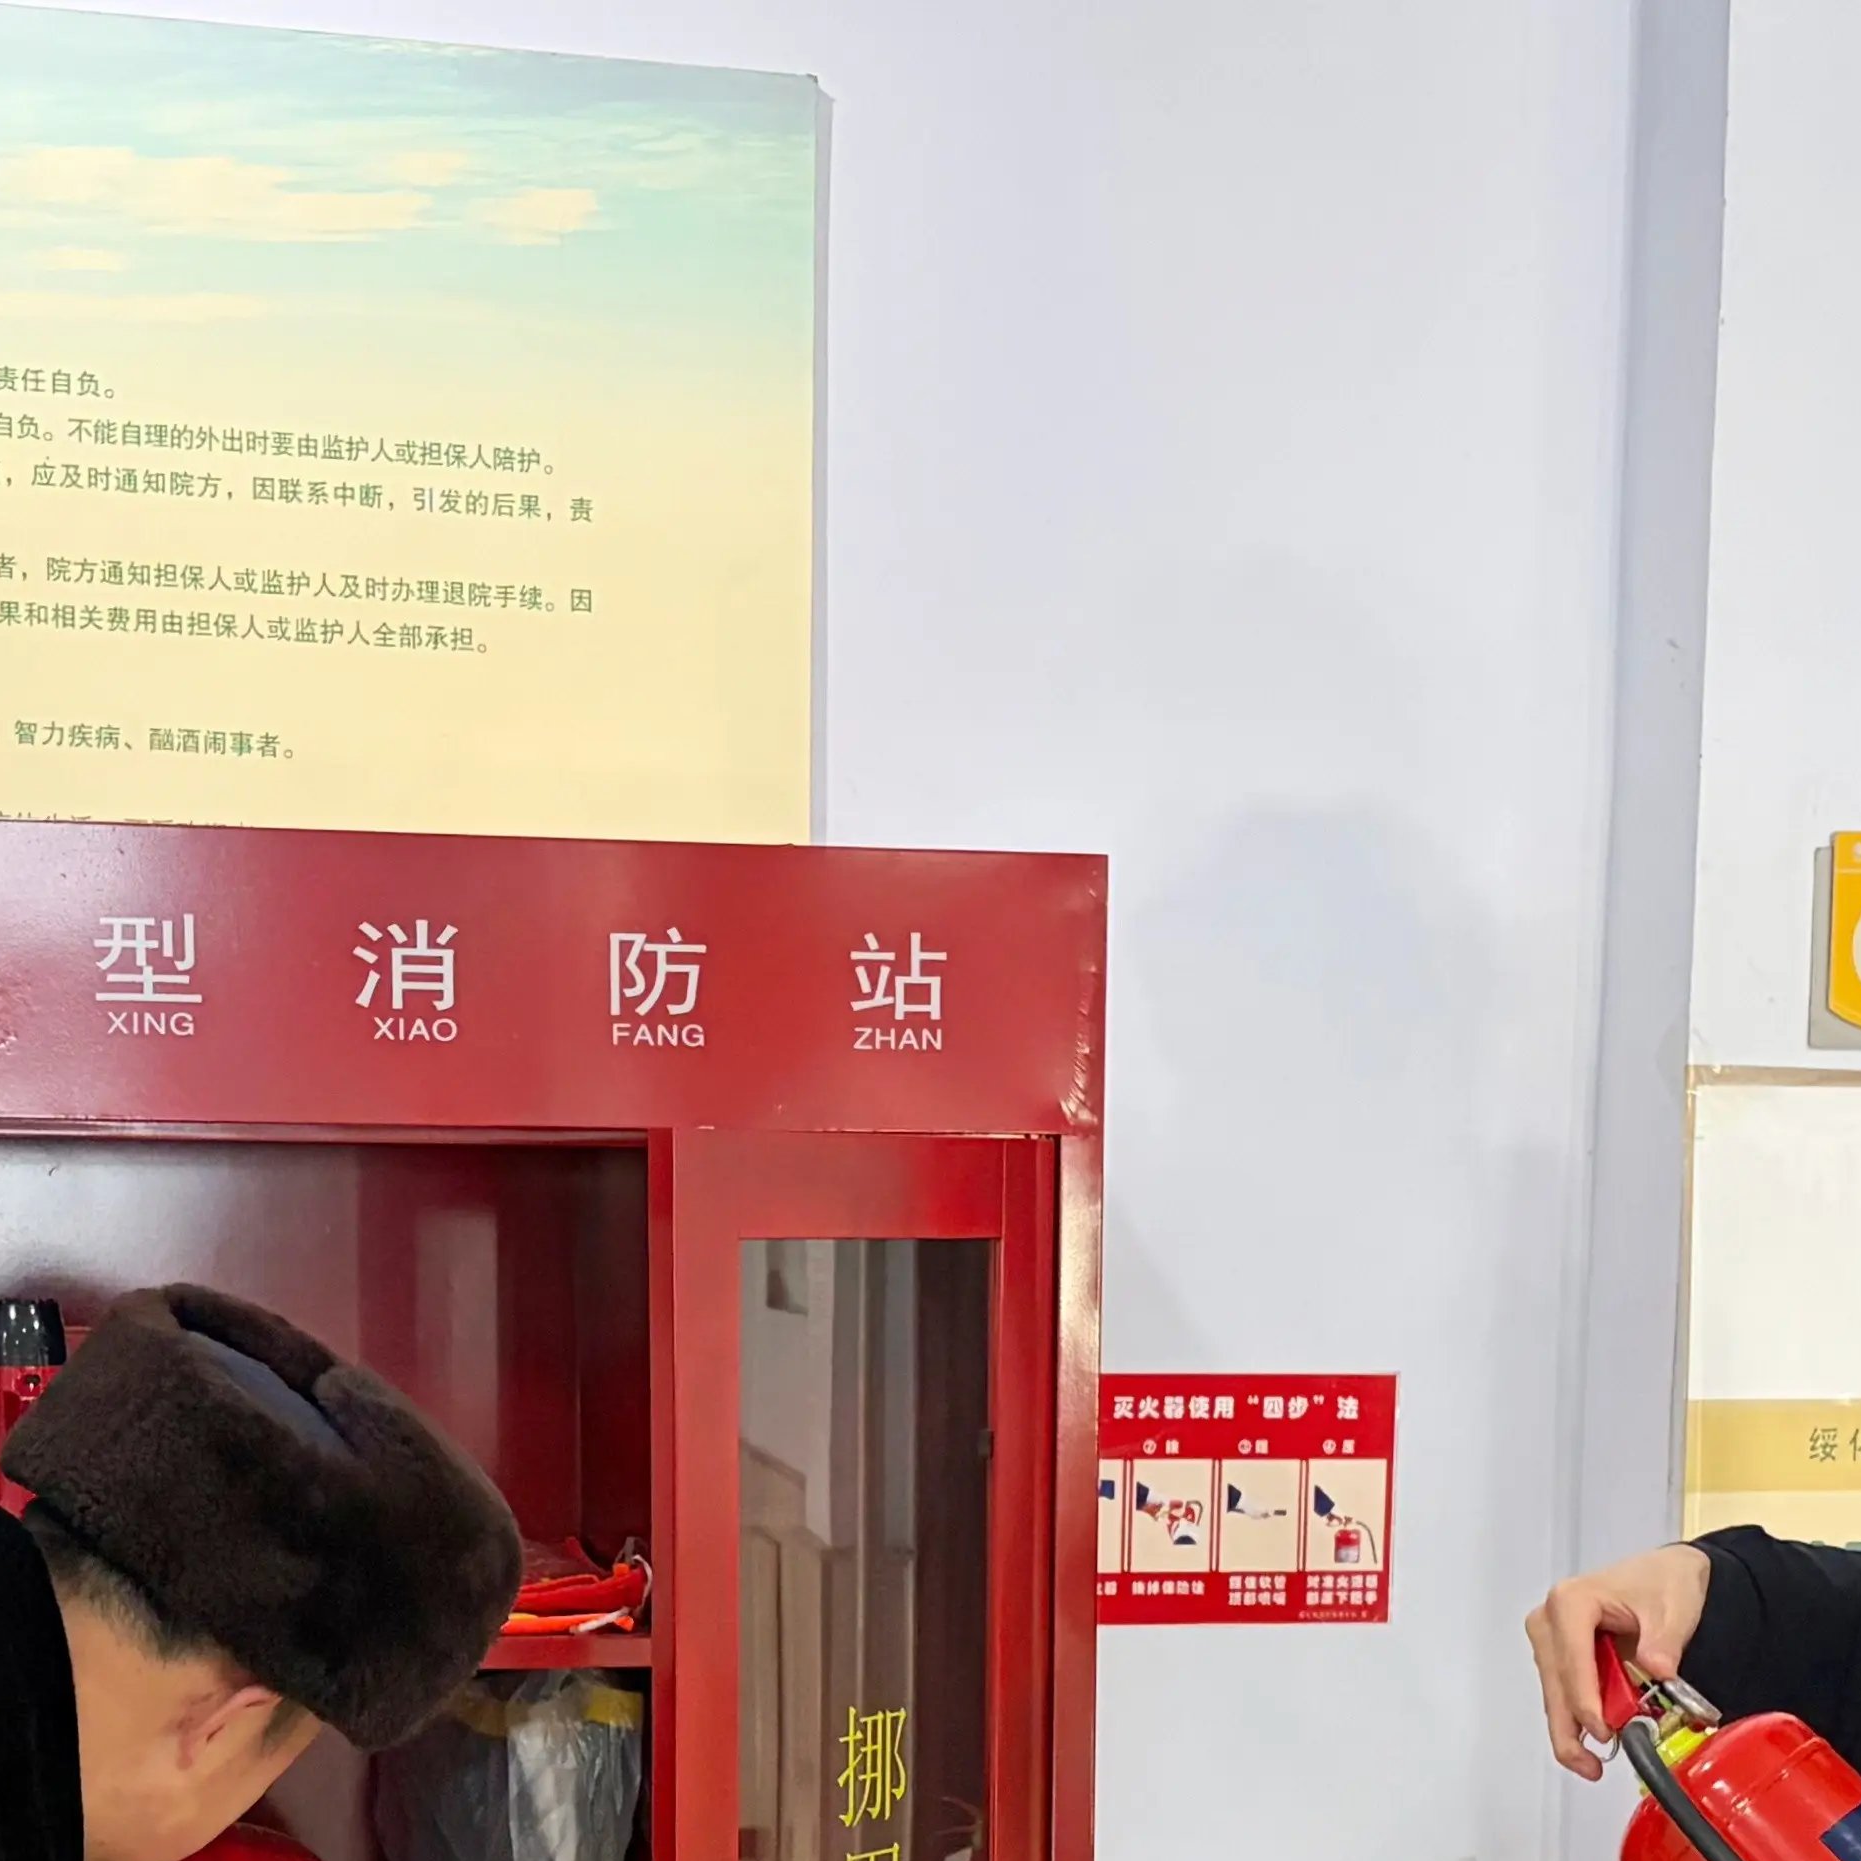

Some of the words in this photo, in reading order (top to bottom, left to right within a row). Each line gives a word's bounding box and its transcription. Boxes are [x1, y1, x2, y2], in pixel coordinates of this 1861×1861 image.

[106, 1010, 196, 1036] XING
[372, 1017, 459, 1043] XIAO
[612, 1022, 706, 1048] FANG
[853, 1027, 944, 1051] ZHAN
